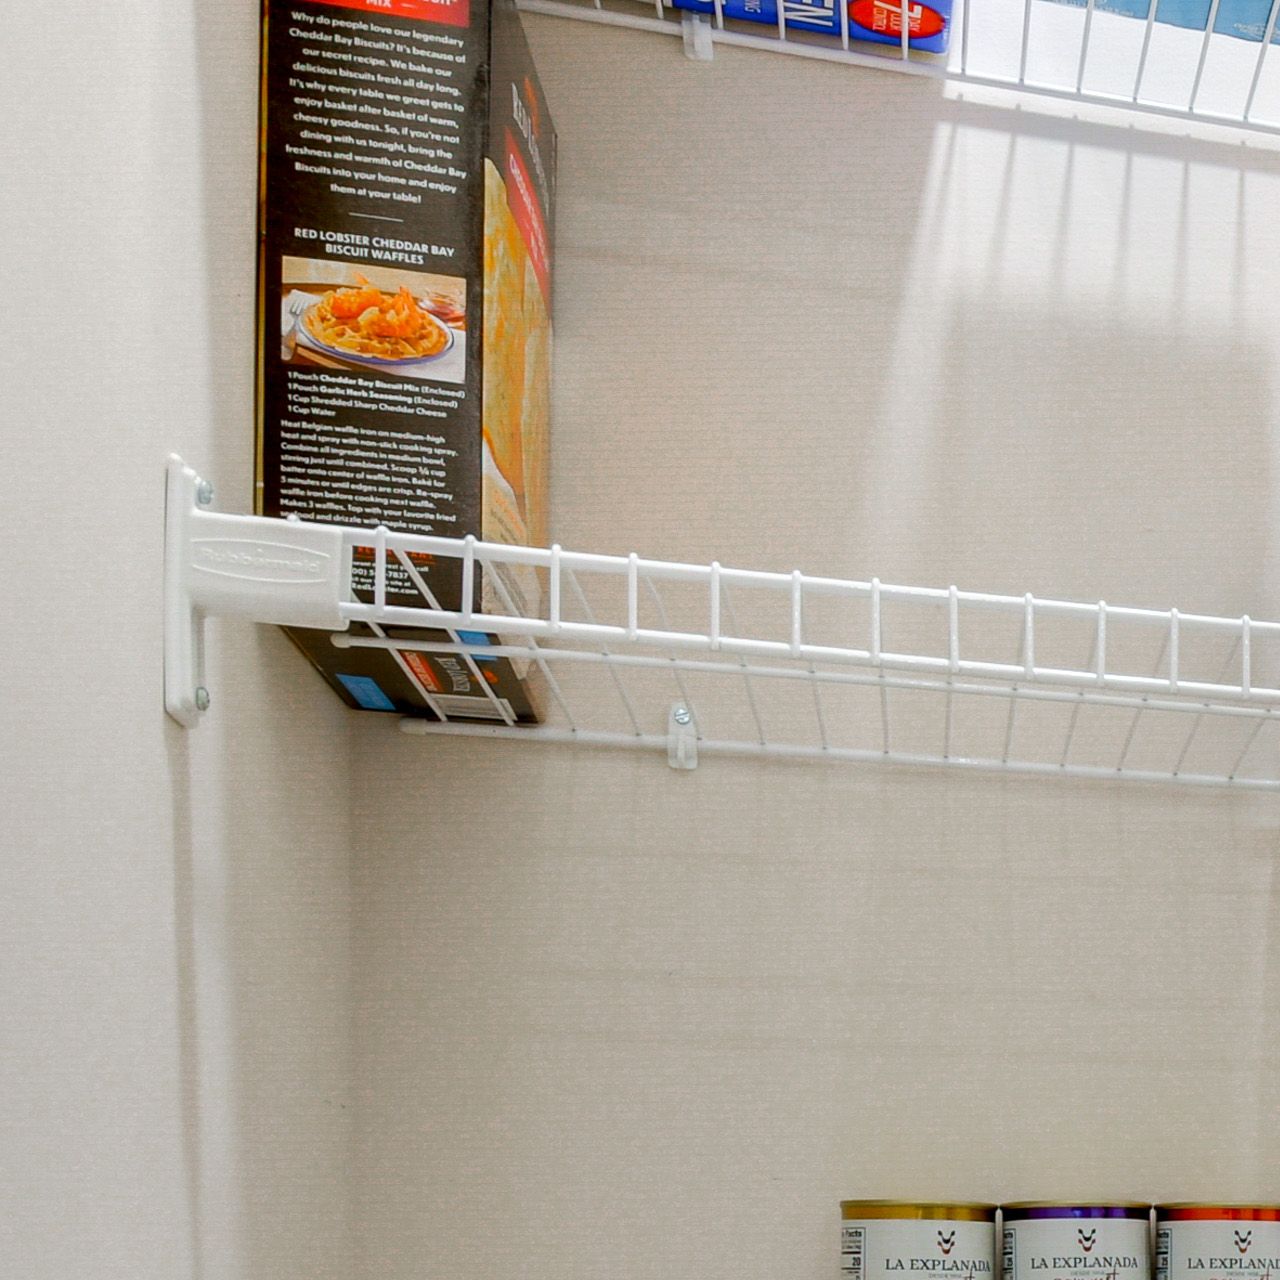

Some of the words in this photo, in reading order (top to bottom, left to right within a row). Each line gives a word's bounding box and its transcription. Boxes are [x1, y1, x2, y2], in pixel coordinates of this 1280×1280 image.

[291, 11, 314, 25] Why
[316, 16, 330, 26] do
[332, 18, 369, 31] people
[370, 23, 392, 35] love
[394, 28, 411, 38] our
[412, 30, 463, 48] legendary
[294, 227, 318, 239] RED
[320, 230, 370, 246] LOBSTER
[372, 236, 428, 254] CHEDDAR
[431, 245, 455, 257] BAY
[325, 243, 369, 258] BISCUIT
[371, 248, 424, 265] WAFFLES
[885, 1258, 904, 1270] LA
[910, 1259, 991, 1272] EXPLANADA
[1031, 1258, 1048, 1269] LA
[1053, 1257, 1138, 1269] EXPLANADA
[1187, 1258, 1205, 1269] LA
